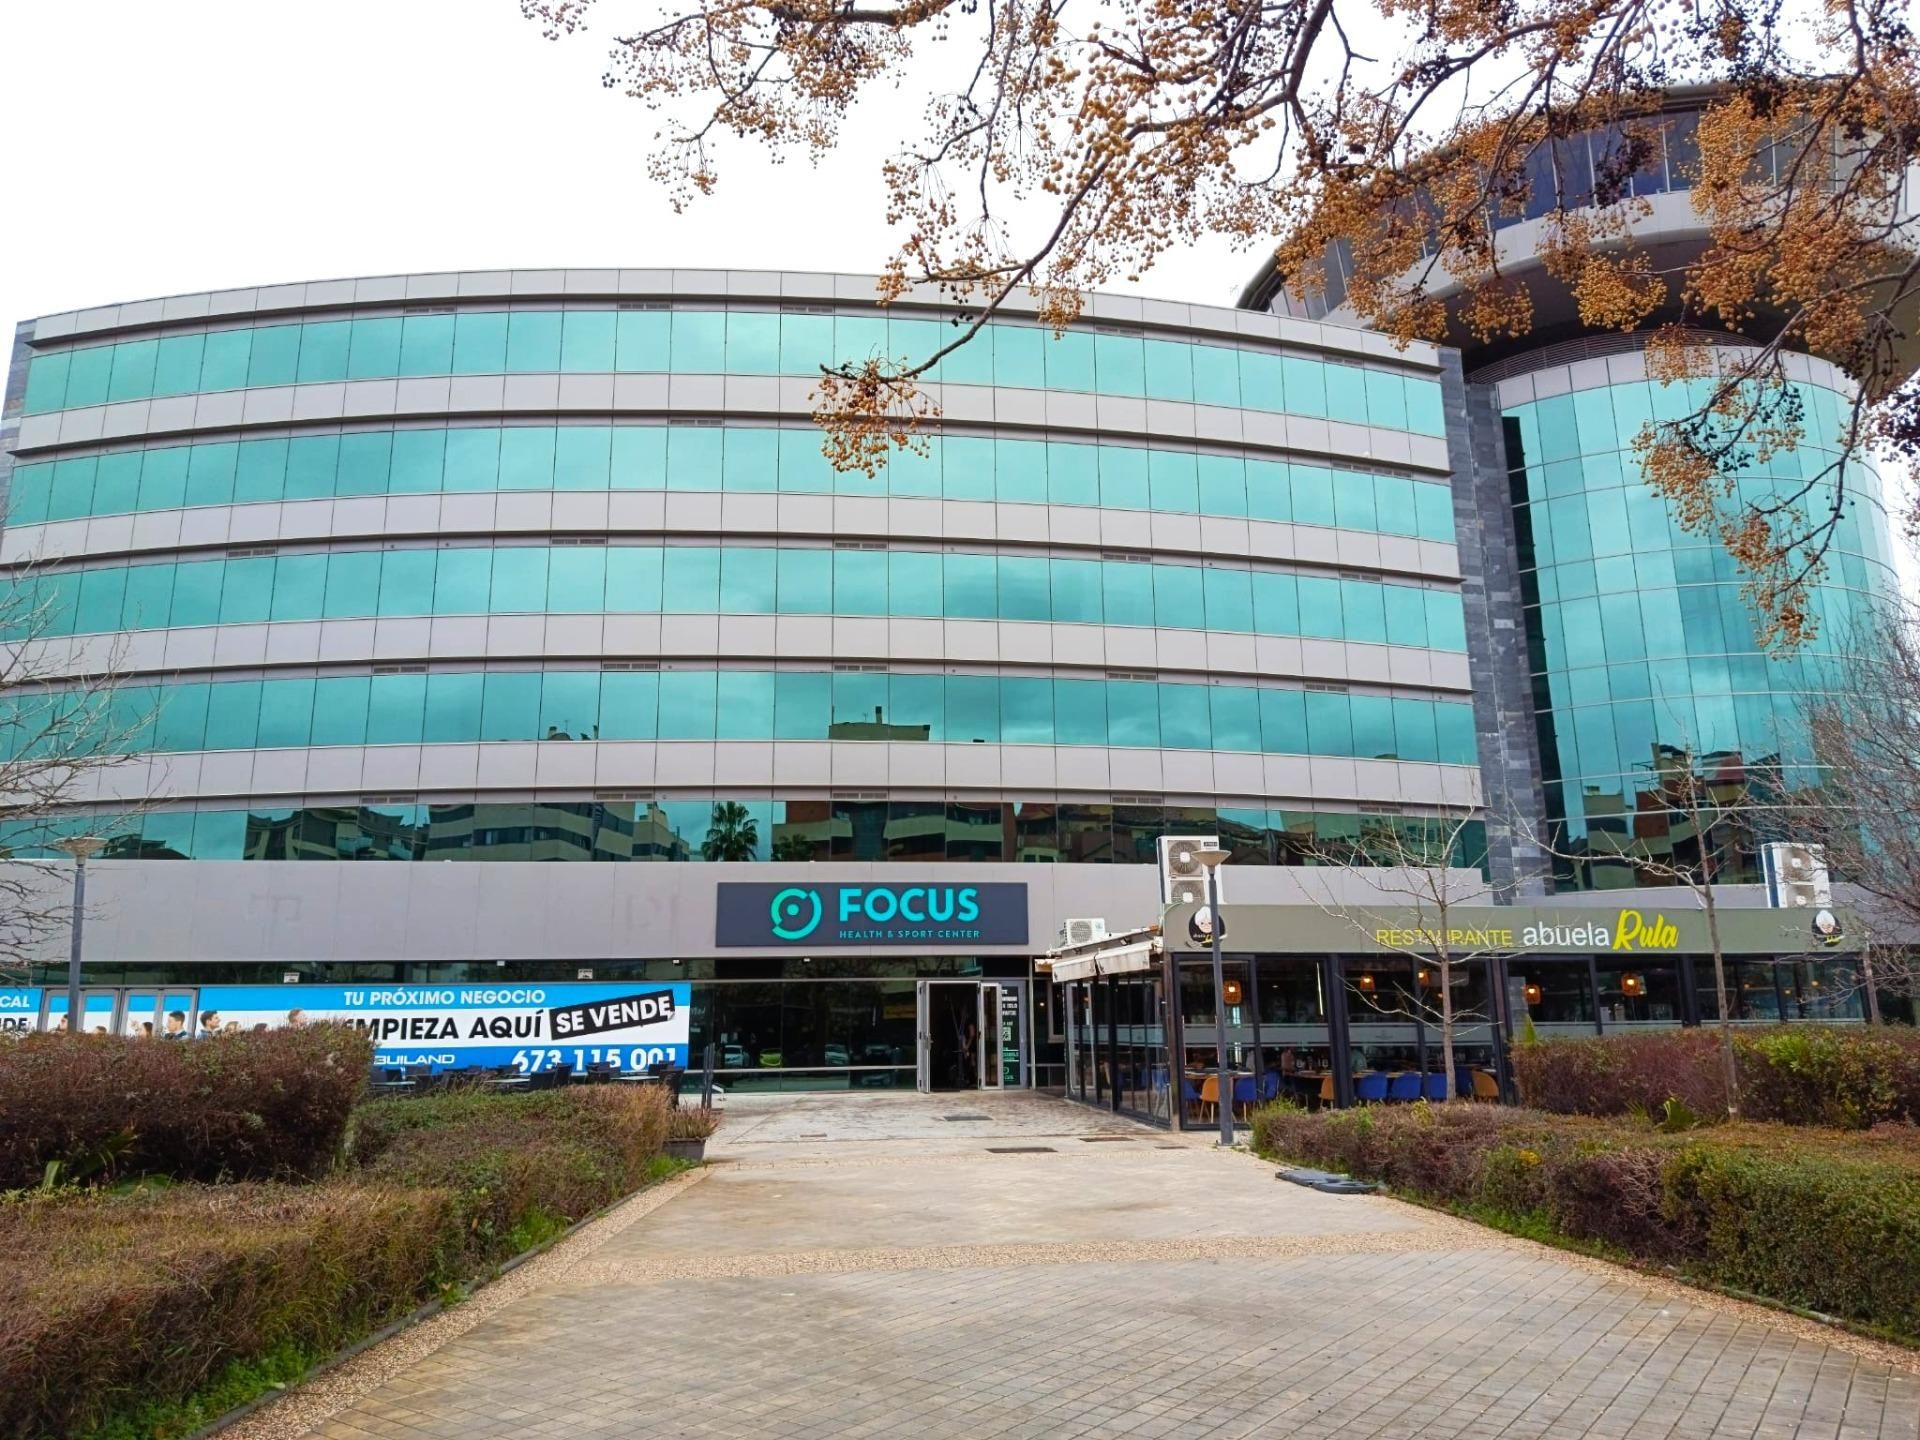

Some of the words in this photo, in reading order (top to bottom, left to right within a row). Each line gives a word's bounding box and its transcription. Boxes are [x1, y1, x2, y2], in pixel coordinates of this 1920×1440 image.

[839, 887, 980, 922] FOCUS
[839, 930, 883, 939] HEALTH
[887, 930, 894, 939] &
[898, 930, 932, 939] SPORT
[938, 930, 980, 939] CENTER
[1375, 928, 1513, 947] RESTAURANTE
[1522, 920, 1610, 947] abuela
[1612, 908, 1679, 951] Rula
[344, 991, 364, 1006] TU
[370, 987, 455, 1006] PRÓXIMO
[460, 989, 546, 1005] NEGOCIO
[468, 1009, 545, 1039] AQUÍ
[556, 1010, 585, 1034] SE
[589, 995, 671, 1028] VENDE
[511, 1050, 562, 1073] 673
[574, 1048, 622, 1072] 115
